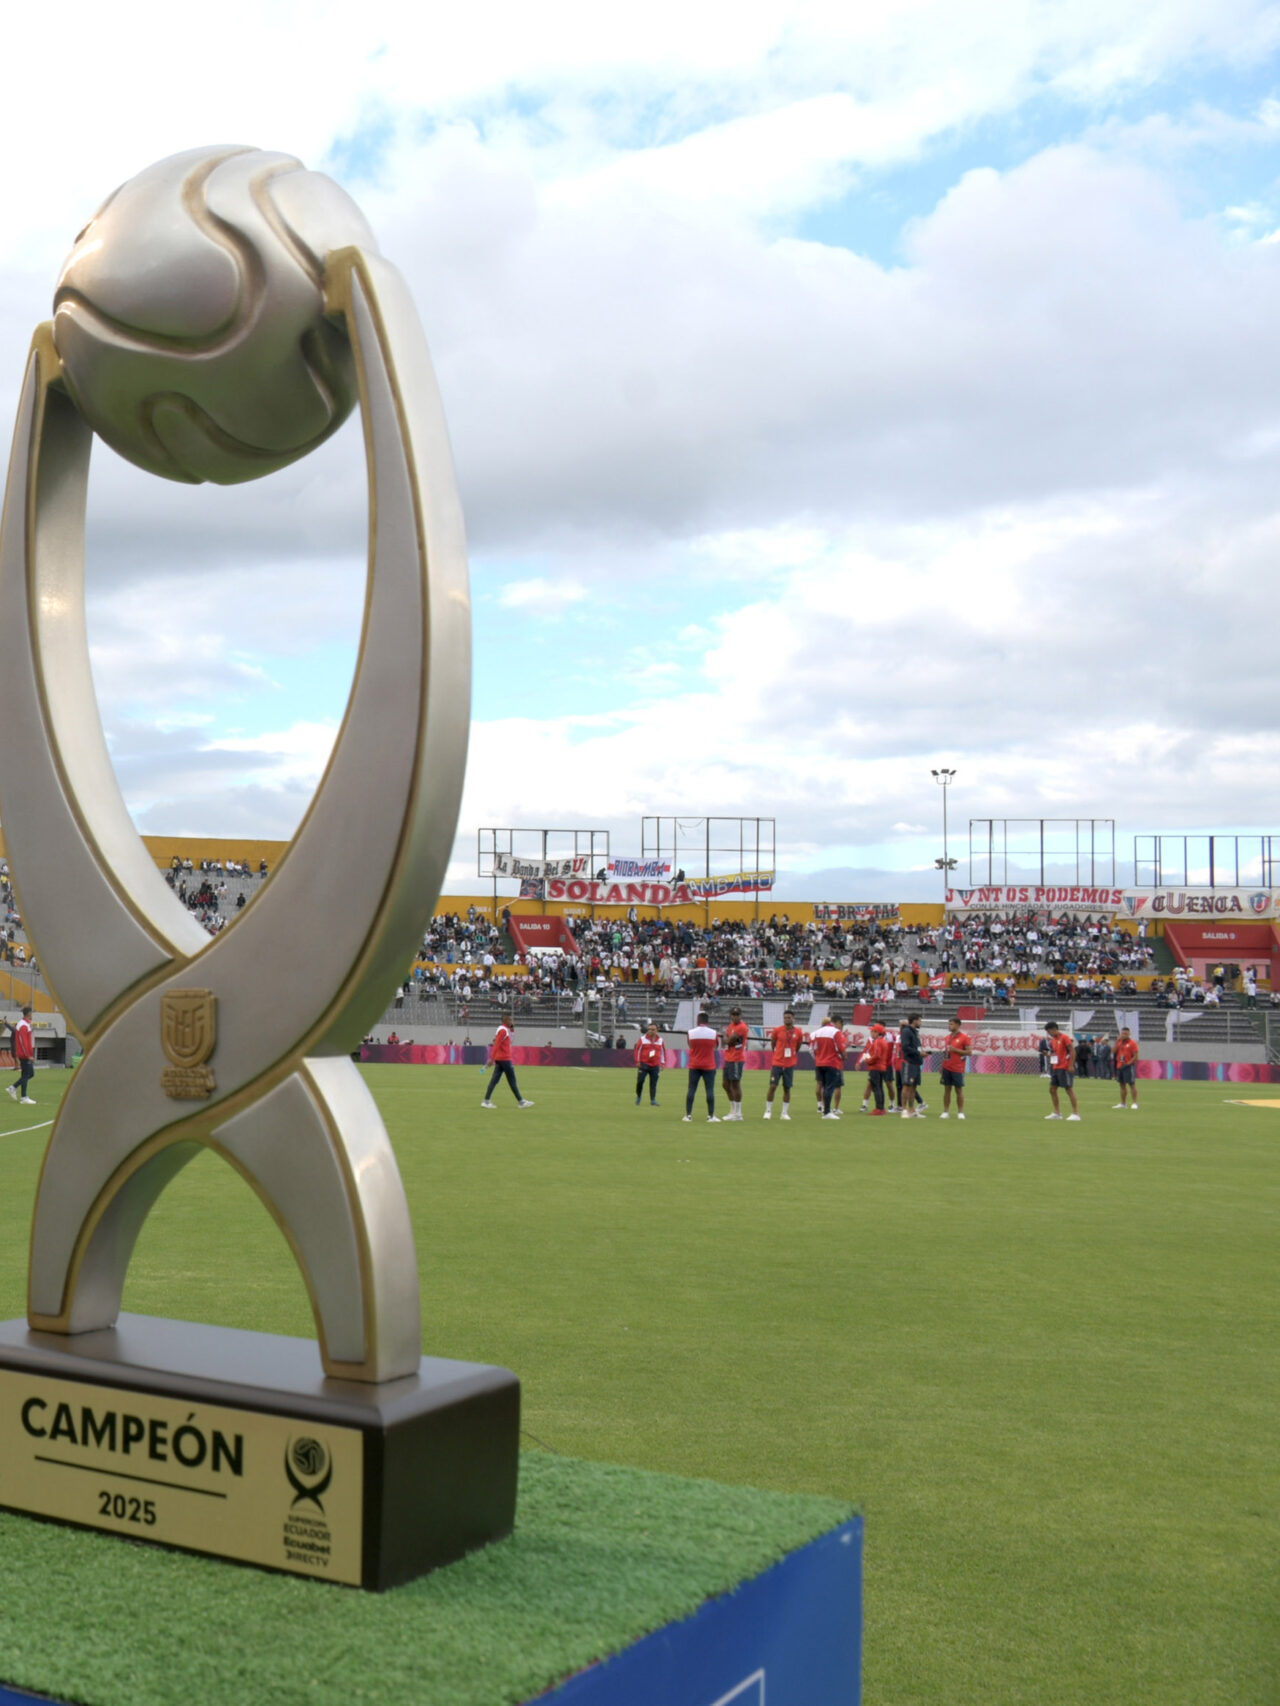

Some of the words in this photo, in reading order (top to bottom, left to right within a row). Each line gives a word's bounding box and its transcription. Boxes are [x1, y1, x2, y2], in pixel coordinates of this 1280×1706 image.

[613, 859, 666, 877] RIOBAMBA
[548, 879, 694, 904] SOLANDA
[689, 873, 771, 896] AMBATO
[1034, 886, 1123, 905] PODEMOS
[1152, 891, 1244, 915] CUENCA
[814, 904, 831, 919] LA
[21, 1397, 244, 1477] CAMPEÓN
[98, 1491, 157, 1526] 2025
[283, 1523, 331, 1542] ECUADOR
[283, 1535, 331, 1555] Ecuabet
